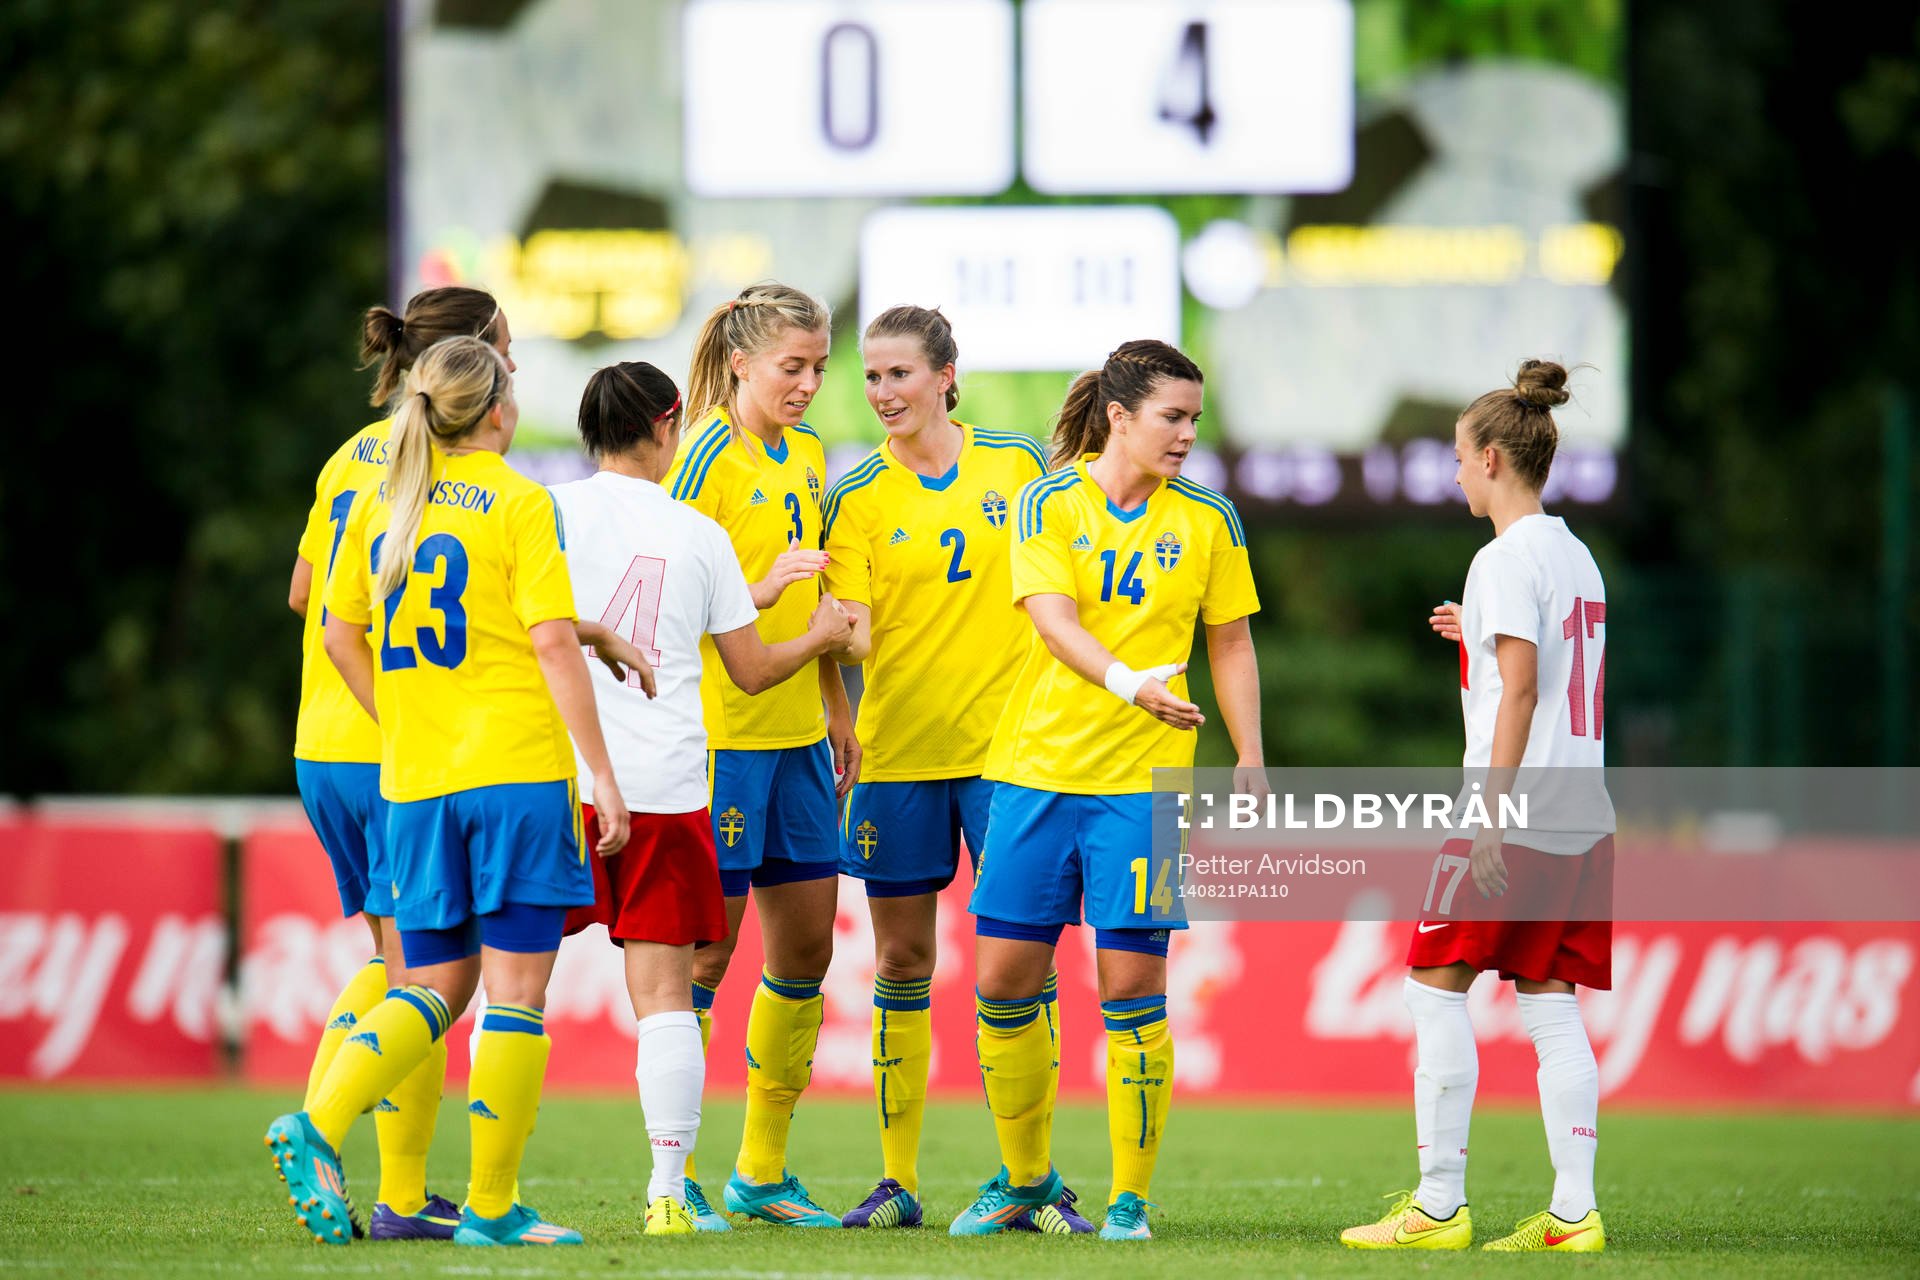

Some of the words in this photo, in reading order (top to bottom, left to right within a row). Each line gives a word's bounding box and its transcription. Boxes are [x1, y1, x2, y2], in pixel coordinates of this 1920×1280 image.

[820, 20, 879, 150] 0
[1158, 19, 1216, 147] 4
[784, 492, 803, 545] 3
[940, 528, 972, 583] 2
[1100, 549, 1146, 605] 14
[370, 533, 469, 672] 23
[589, 555, 666, 687] 4
[1563, 597, 1606, 741] 17
[1130, 857, 1173, 915] 14
[1422, 852, 1471, 915] 17
[1677, 932, 1915, 1066] nas
